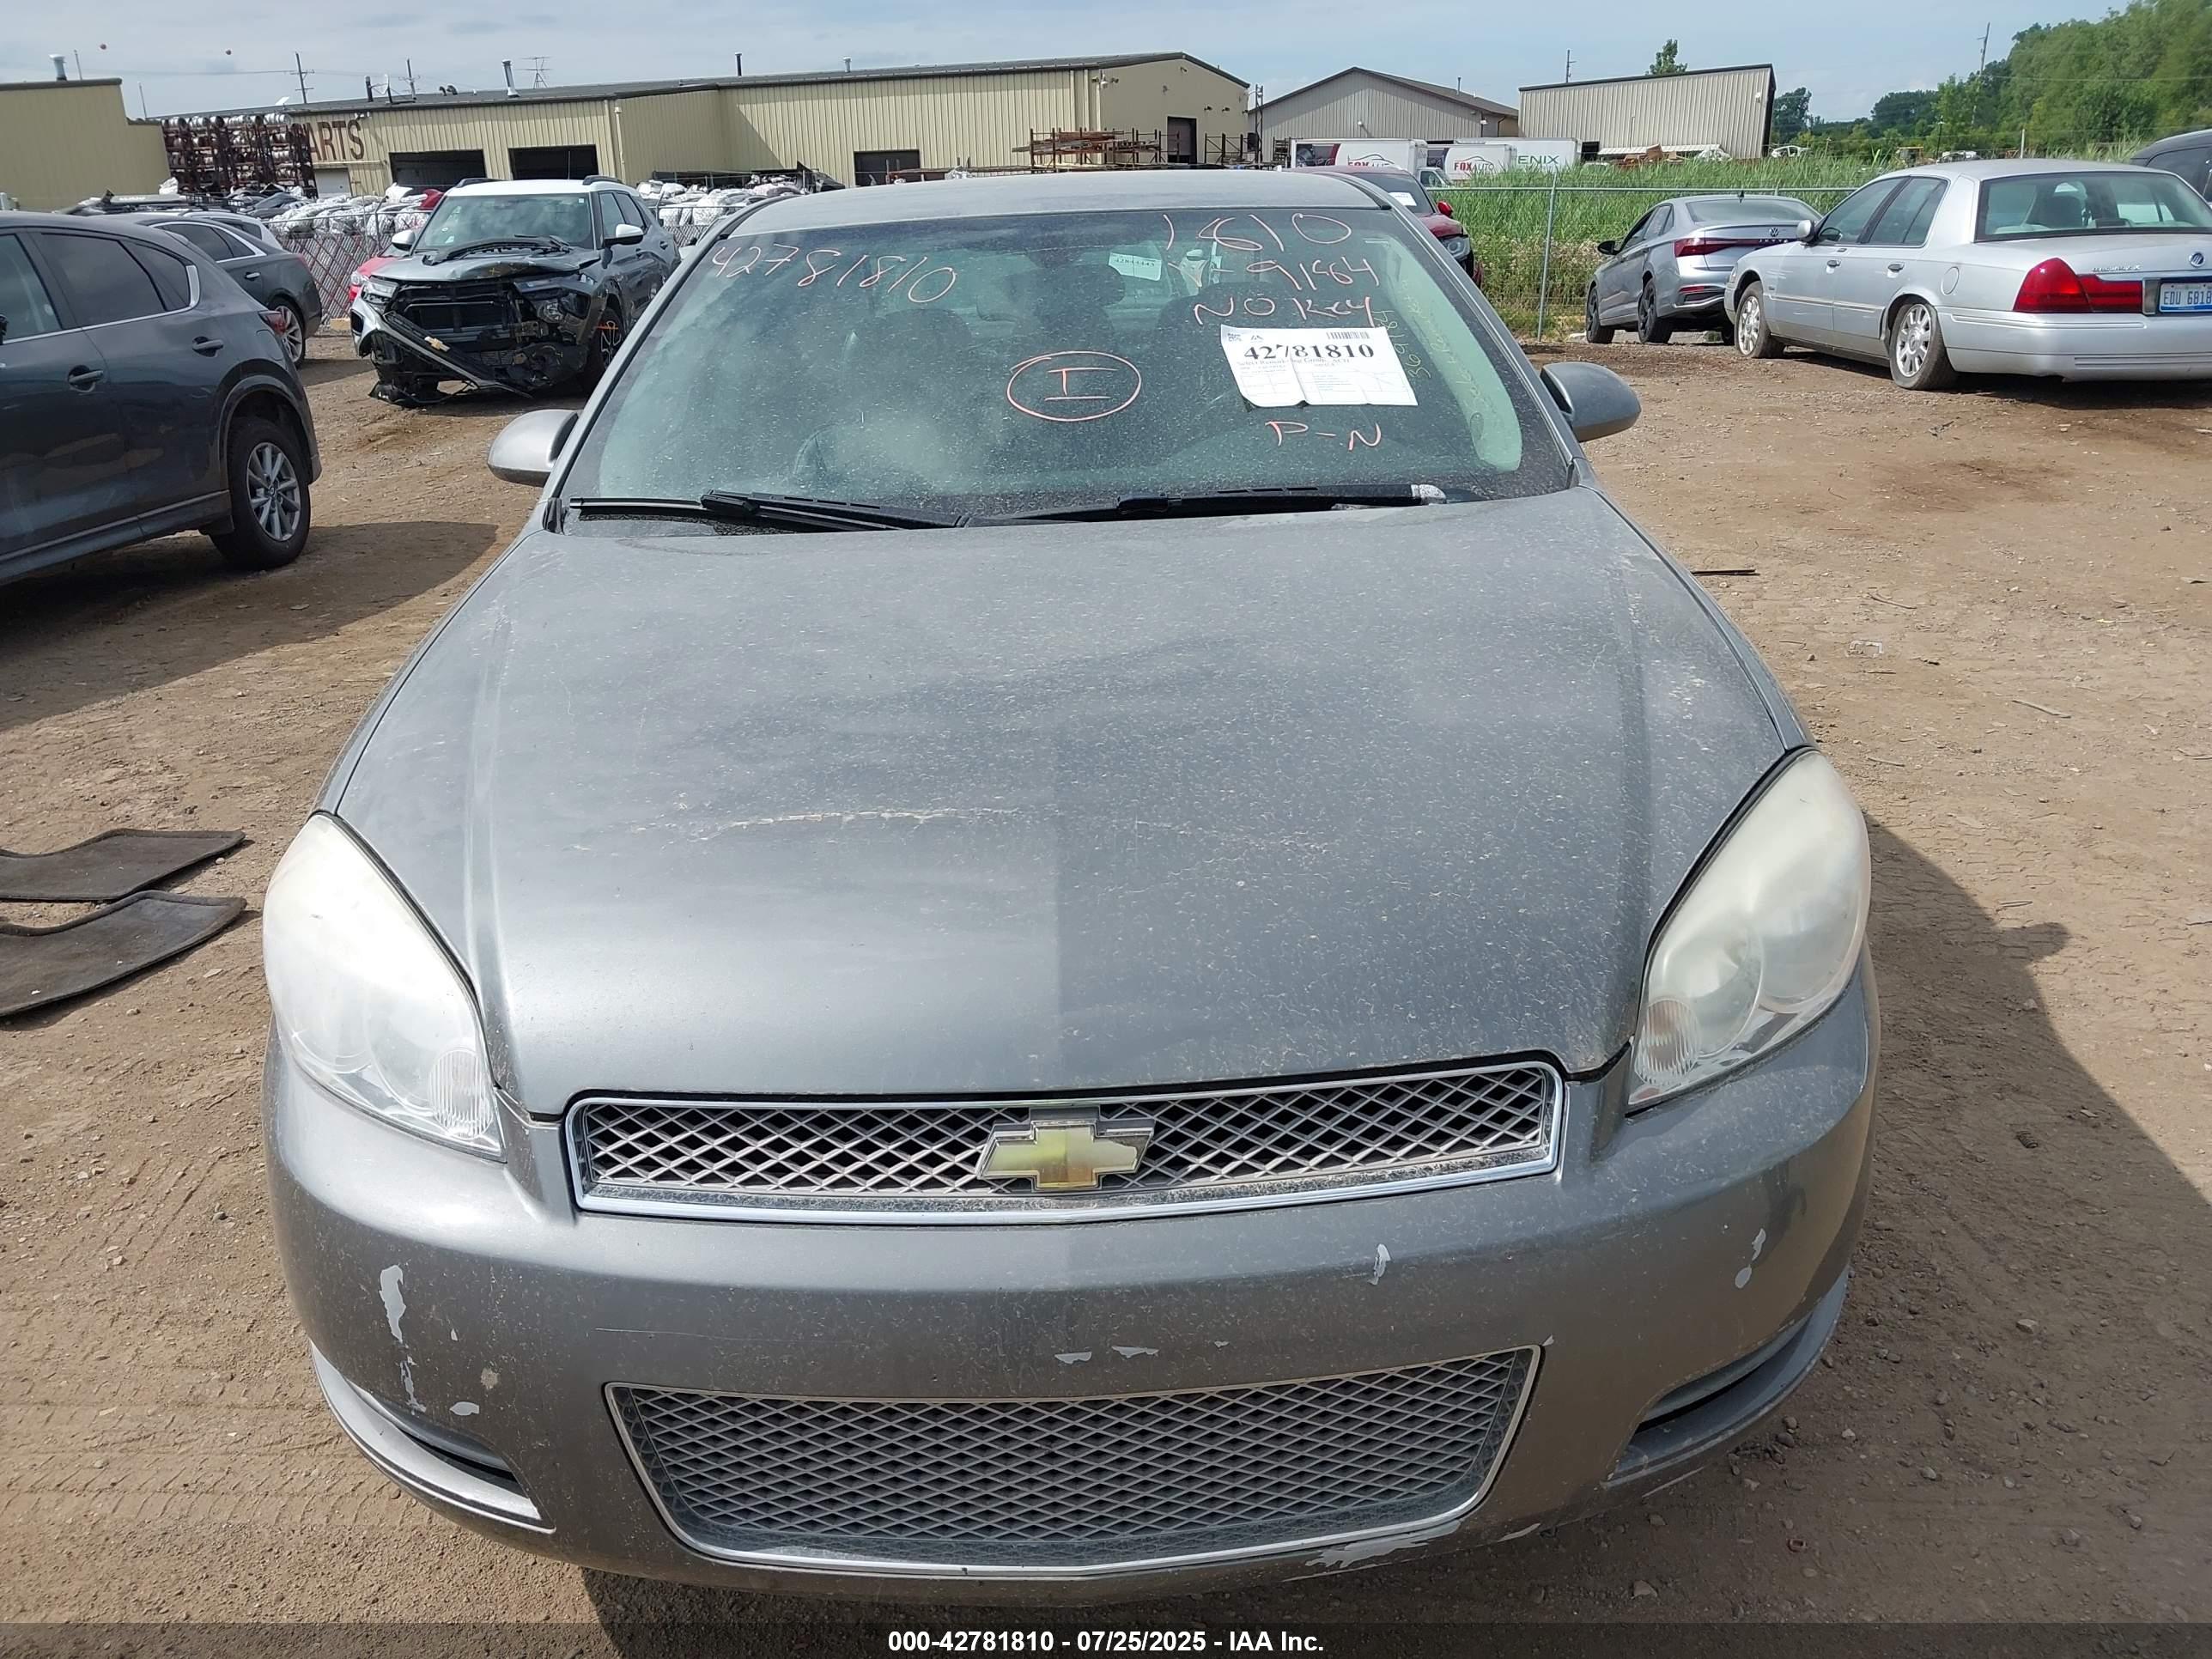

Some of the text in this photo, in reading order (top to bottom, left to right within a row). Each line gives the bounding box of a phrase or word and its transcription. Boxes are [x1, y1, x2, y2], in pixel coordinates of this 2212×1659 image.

[303, 118, 365, 161] ARTS
[711, 243, 958, 302] 42781810
[2163, 290, 2181, 305] EDU
[1243, 343, 1375, 361] 42781810
